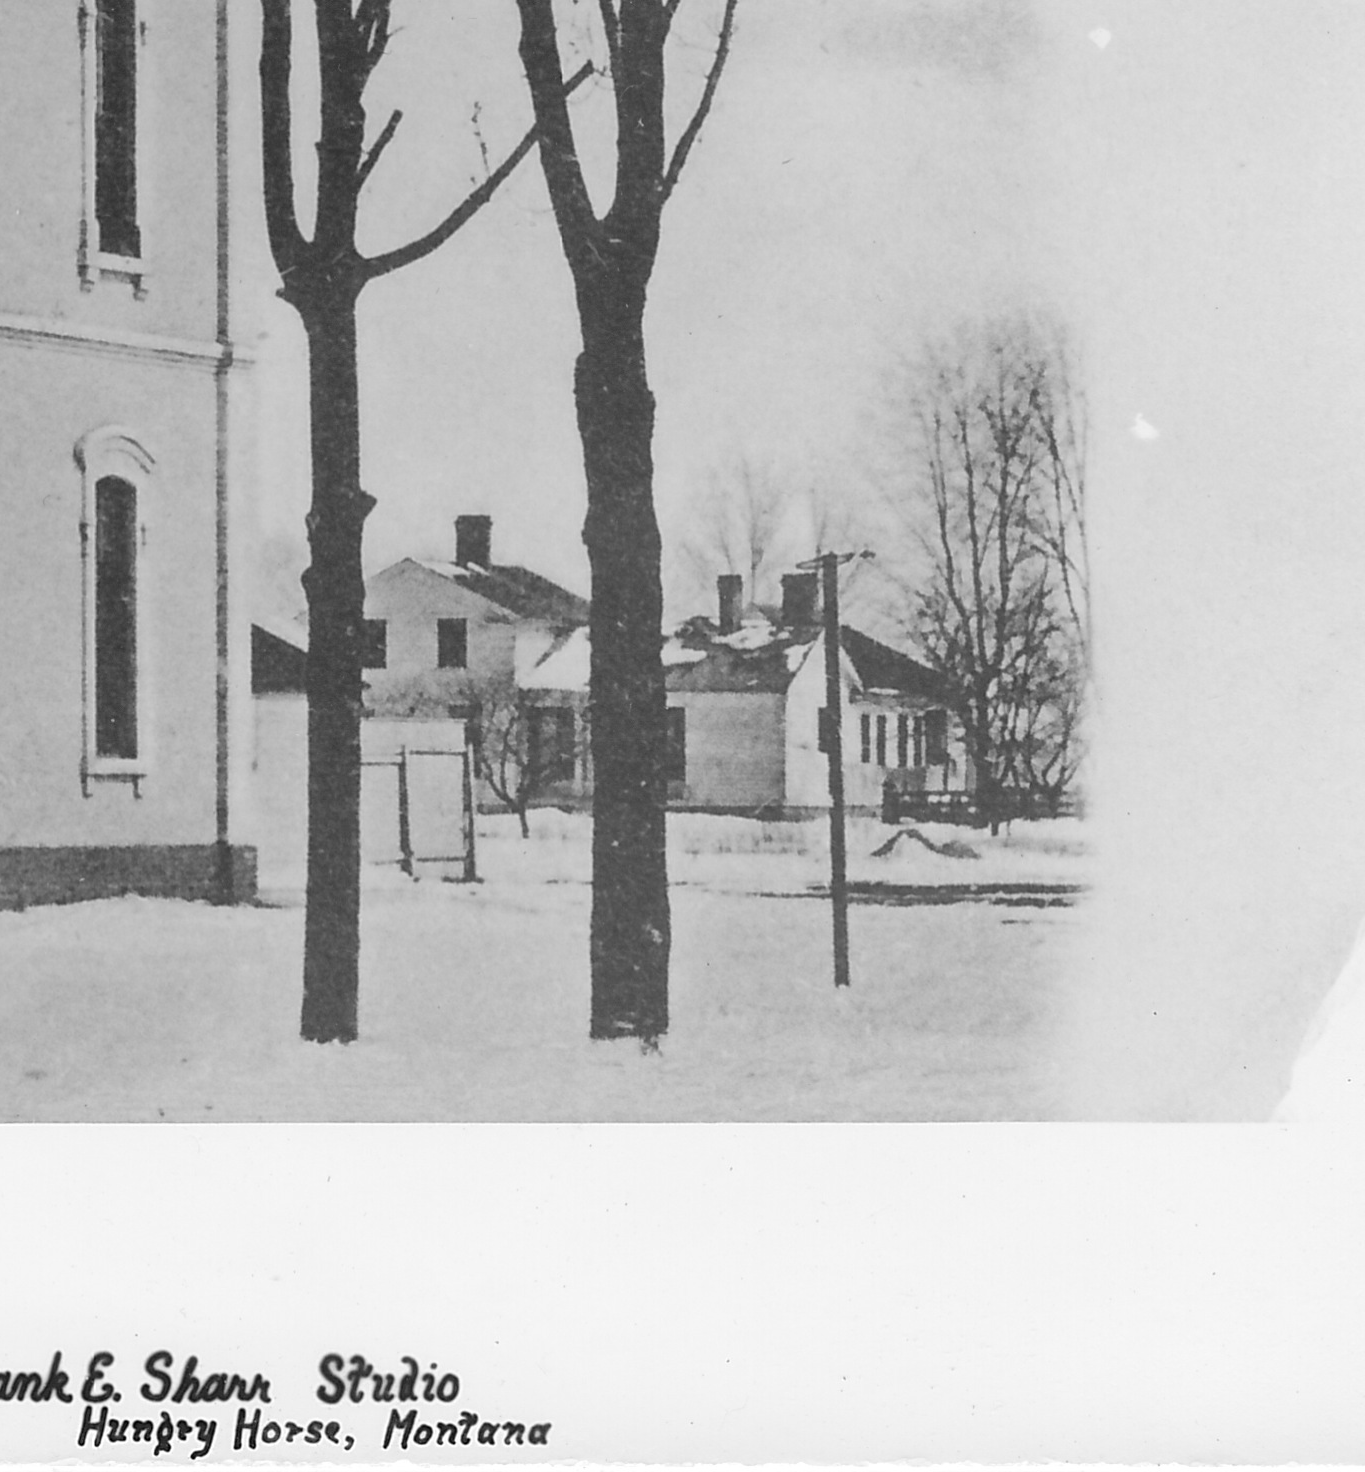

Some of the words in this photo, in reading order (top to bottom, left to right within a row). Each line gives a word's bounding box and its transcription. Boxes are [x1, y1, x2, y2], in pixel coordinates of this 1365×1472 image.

[80, 1351, 122, 1405] E.
[316, 1353, 460, 1405] Studio
[77, 1404, 218, 1461] Hungry
[233, 1407, 355, 1451] Horse,
[382, 1408, 552, 1450] Montana
